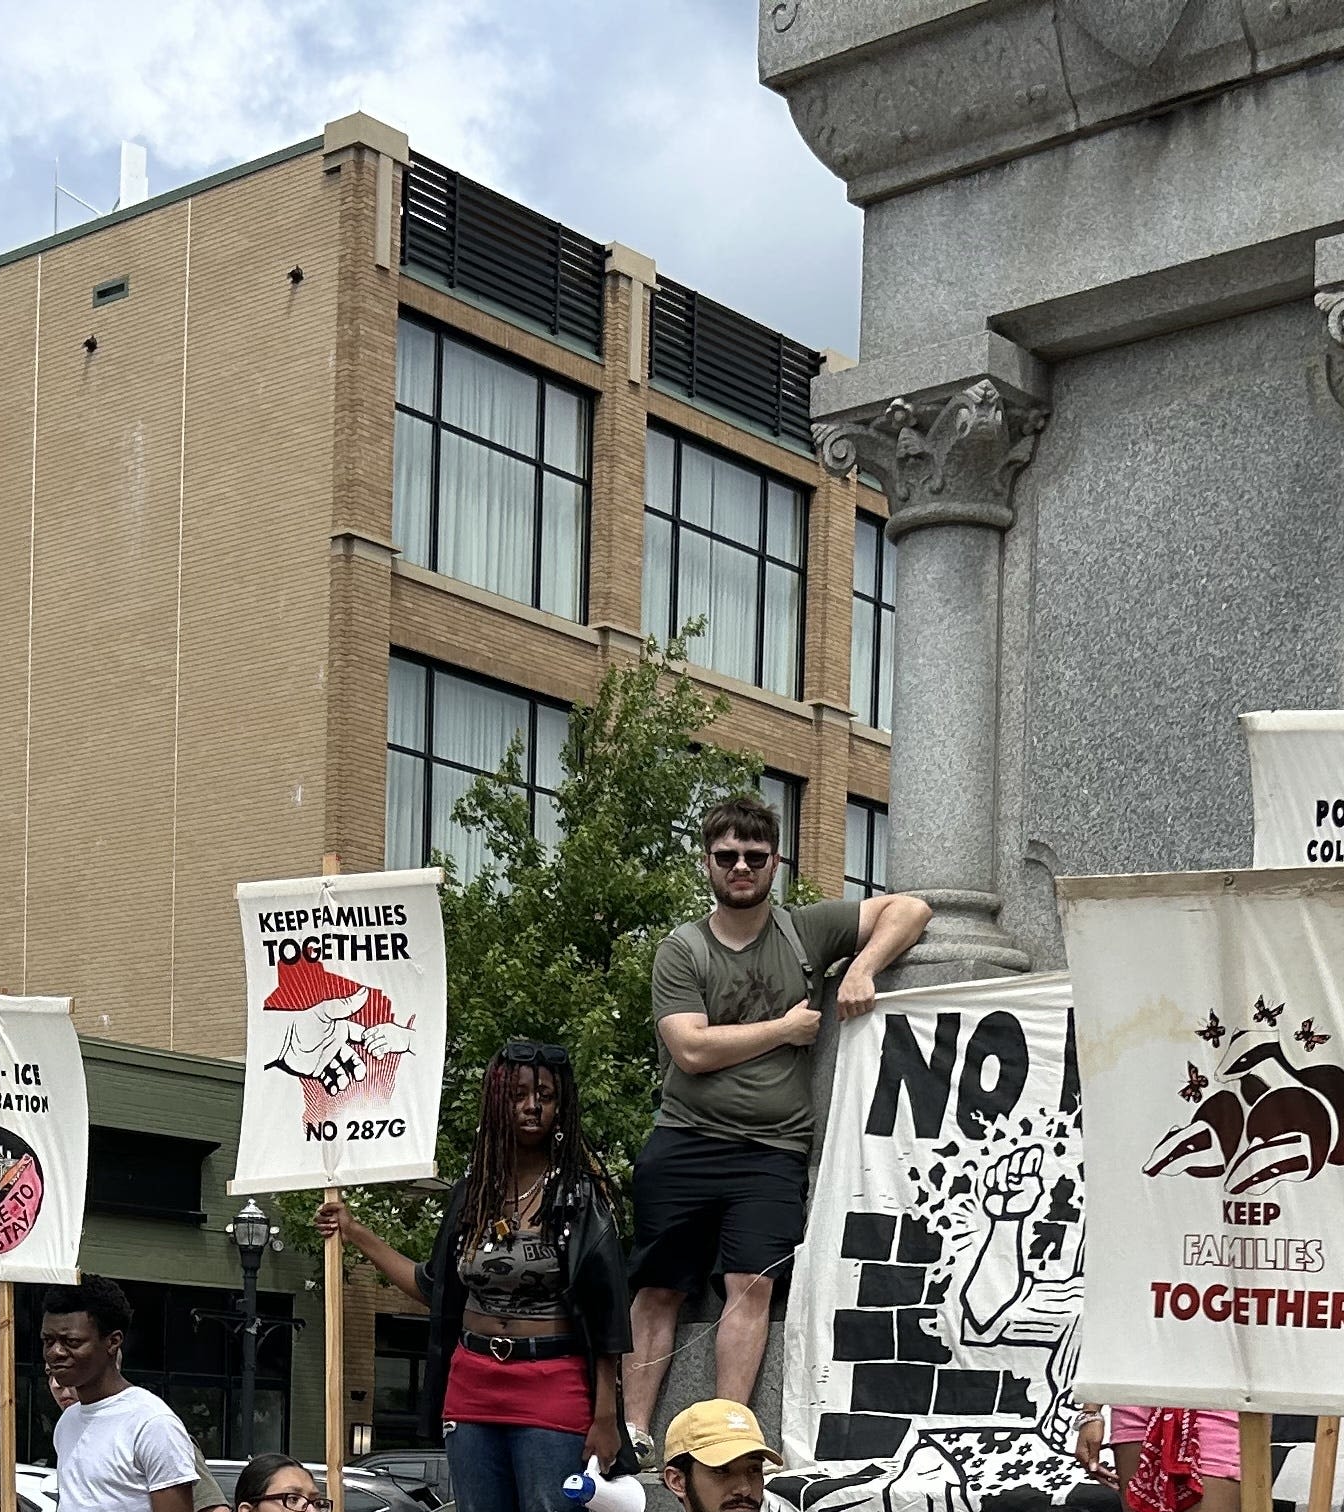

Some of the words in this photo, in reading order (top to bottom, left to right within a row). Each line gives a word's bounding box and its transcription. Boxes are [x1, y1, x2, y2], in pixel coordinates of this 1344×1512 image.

[258, 909, 309, 933] KEEP
[312, 904, 407, 929] FAMILIES
[263, 933, 411, 966] TOGETHER
[14, 1063, 41, 1086] ICE
[864, 1010, 1030, 1141] NO
[306, 1120, 337, 1141] NO
[346, 1118, 406, 1141] 287G
[9, 1184, 33, 1207] TO
[1222, 1200, 1281, 1226] KEEP
[1183, 1234, 1324, 1273] FAMILIES
